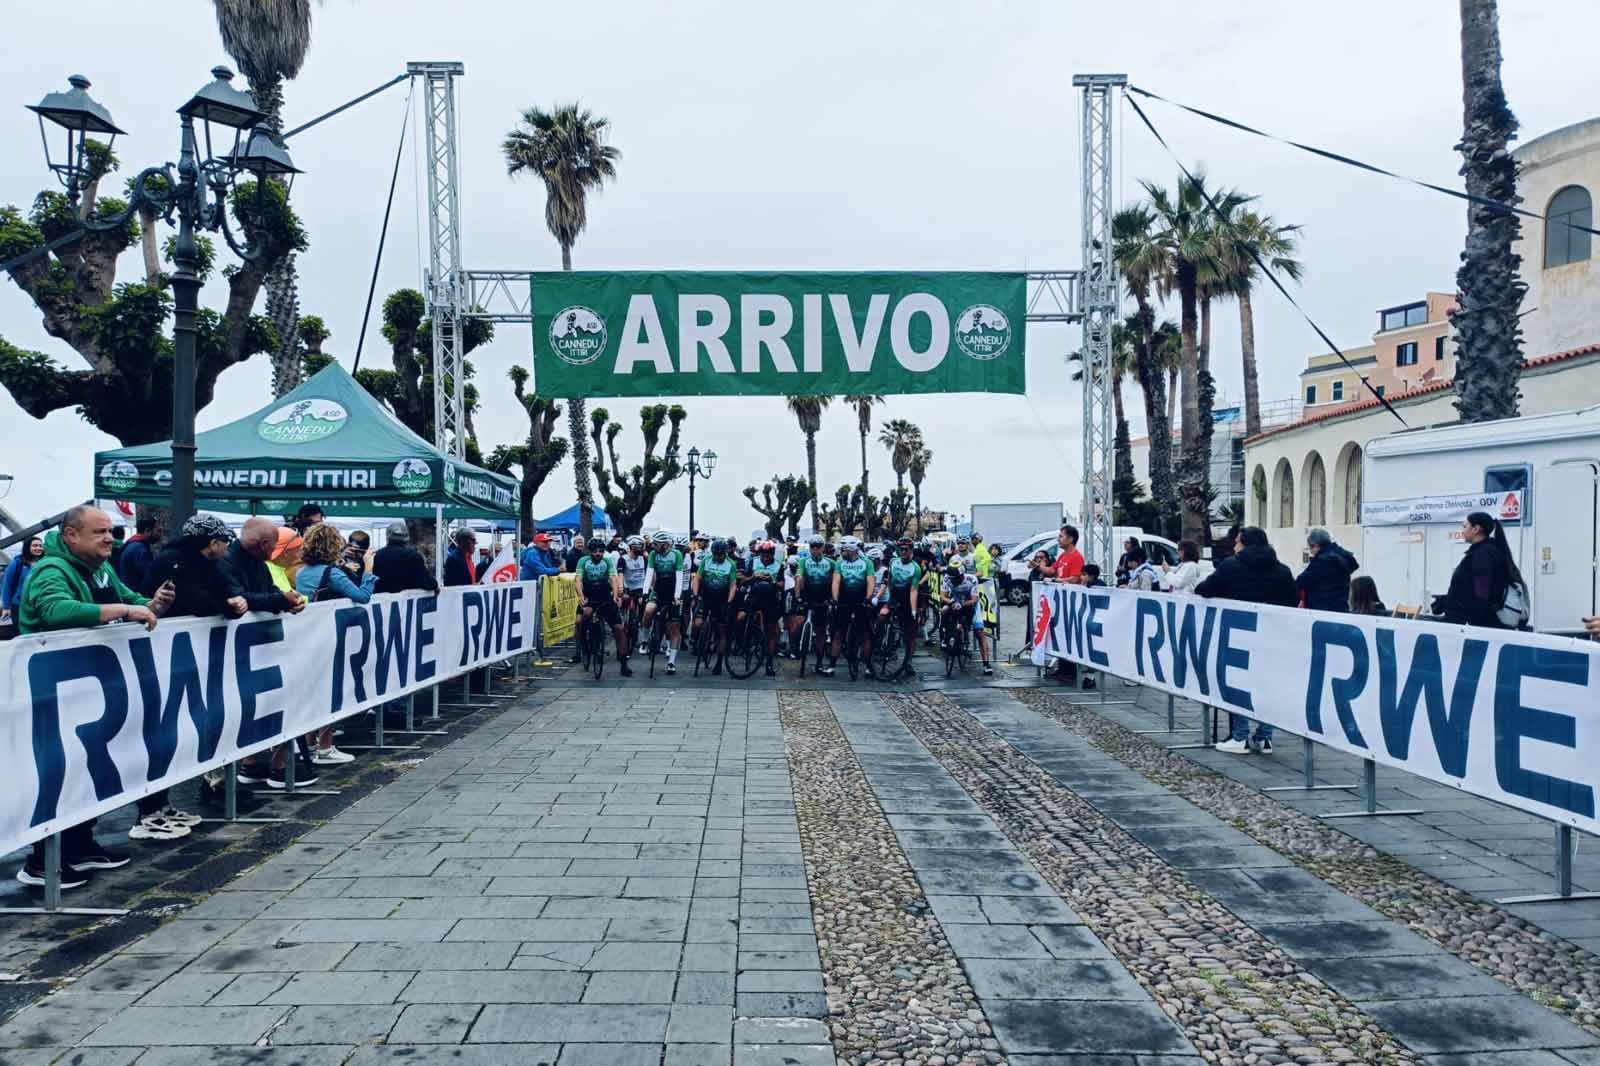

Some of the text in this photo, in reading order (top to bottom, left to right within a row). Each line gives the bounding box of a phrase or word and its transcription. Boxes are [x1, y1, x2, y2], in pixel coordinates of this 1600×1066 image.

[558, 339, 599, 349] CANNEDU
[613, 292, 950, 374] ARRIVO
[963, 335, 1003, 345] CANNEDU
[263, 423, 335, 434] CANNEDU
[154, 469, 376, 489] CNNEDU ITTIRI
[458, 475, 492, 500] CANNEDU
[28, 587, 524, 828] RWE RWE RWE
[1049, 588, 1111, 667] RWE
[1135, 598, 1259, 713] RWE
[1305, 620, 1596, 820] RWE
